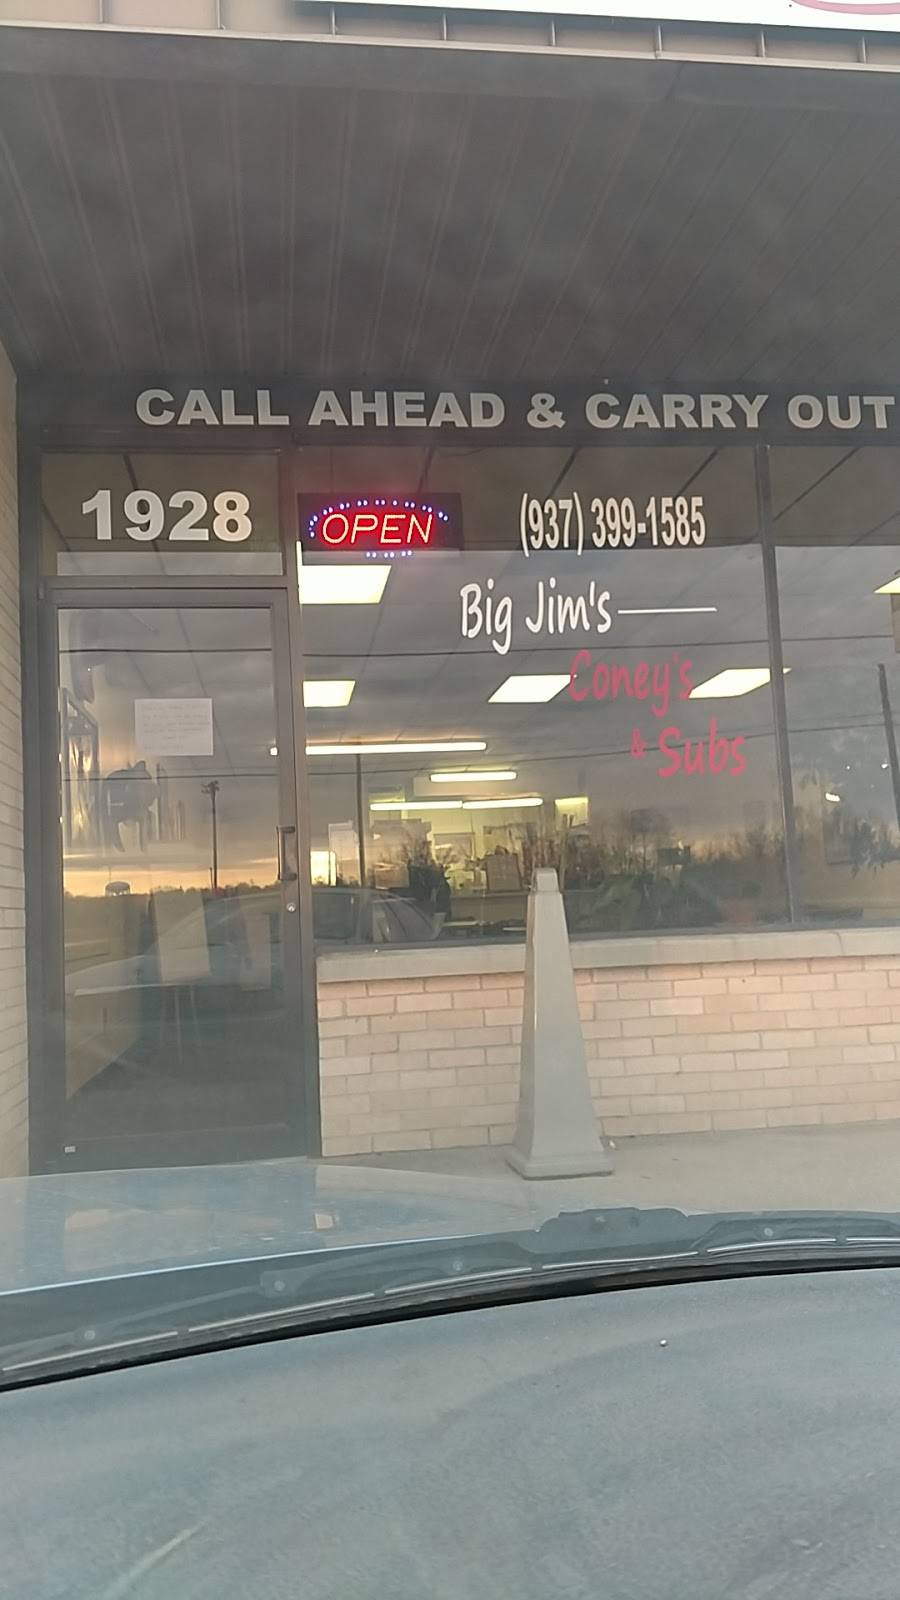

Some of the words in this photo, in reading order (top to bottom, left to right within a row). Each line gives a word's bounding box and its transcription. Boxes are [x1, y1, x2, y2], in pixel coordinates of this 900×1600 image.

[135, 388, 290, 426] CALL
[308, 389, 506, 429] AHEAD
[526, 392, 566, 429] &
[585, 392, 769, 429] CARRY
[787, 394, 895, 430] OUT
[81, 489, 253, 542] 1928
[321, 512, 435, 545] OPEN
[519, 492, 584, 558] (937)
[590, 495, 707, 548] 399-1585
[460, 578, 513, 655] Big
[525, 576, 611, 634] Jim's
[569, 648, 693, 718] Coney's
[630, 728, 646, 759] &
[658, 718, 747, 778] Subs
